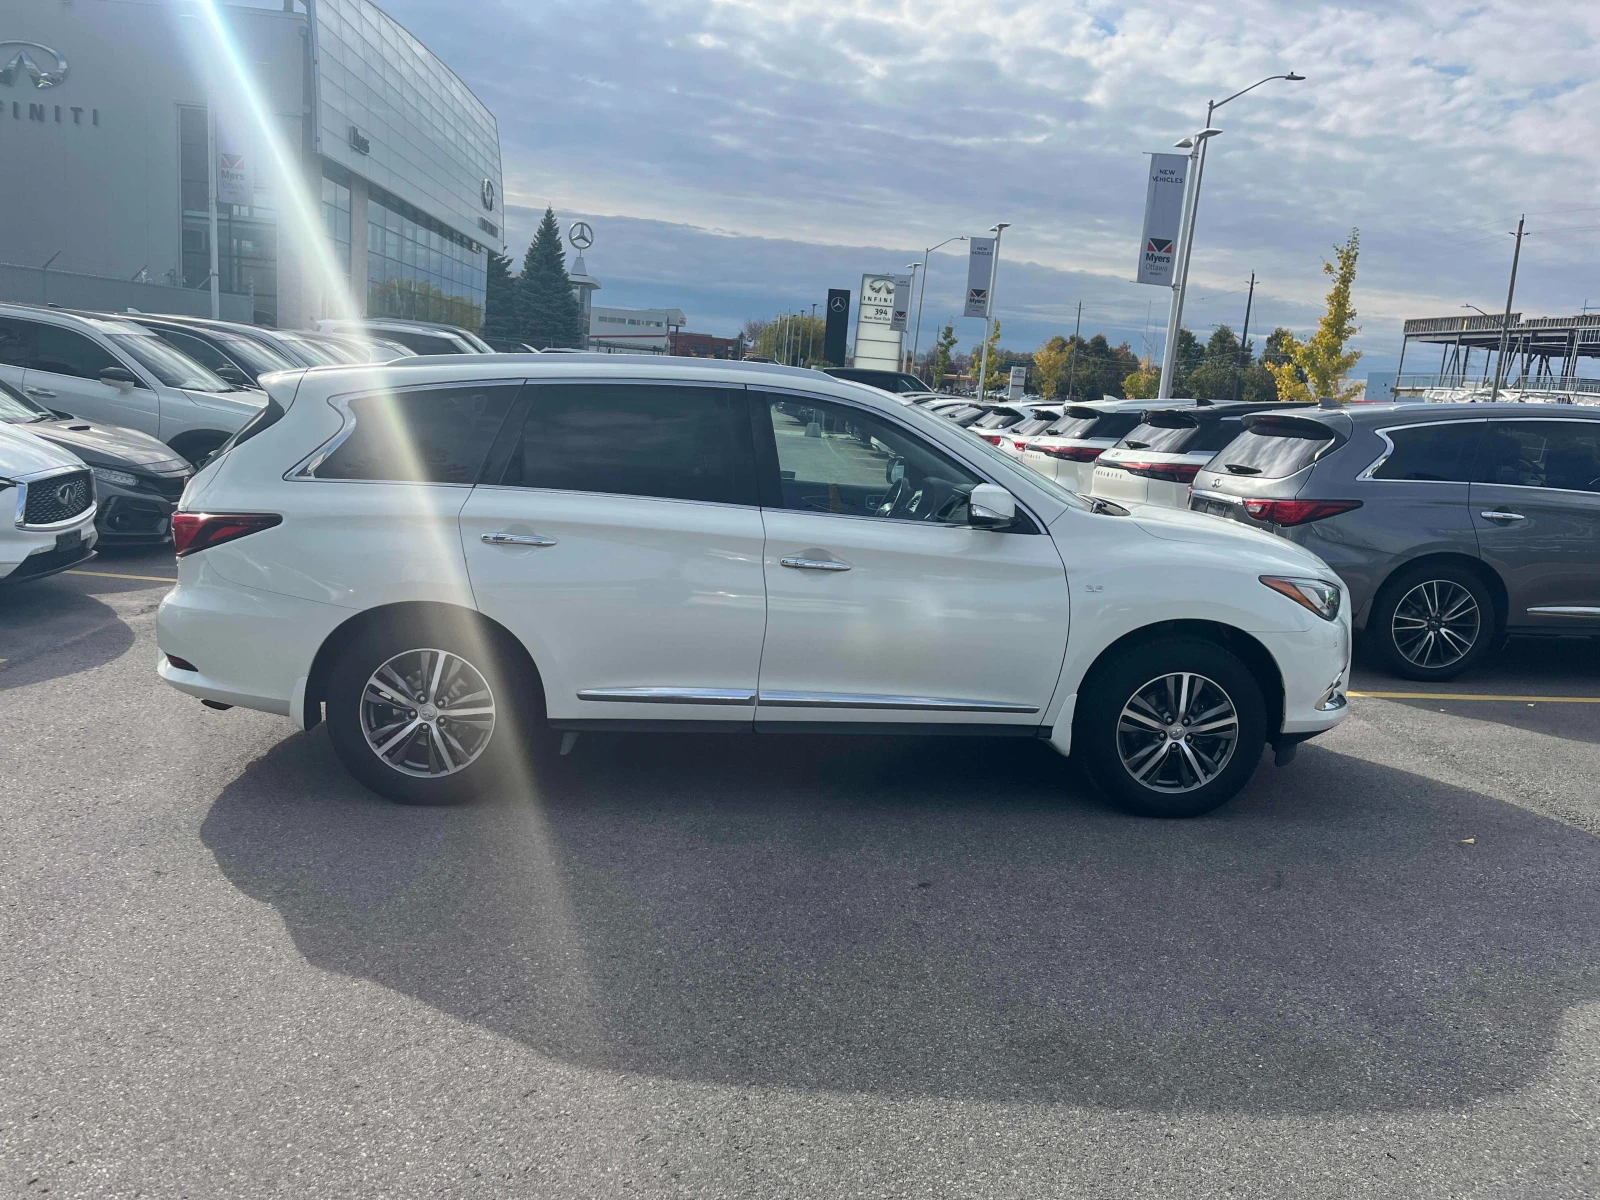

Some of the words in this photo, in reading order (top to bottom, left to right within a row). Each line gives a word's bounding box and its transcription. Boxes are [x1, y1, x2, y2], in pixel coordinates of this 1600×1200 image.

[221, 169, 245, 181] Myers
[1152, 176, 1183, 184] VEHICLES
[1145, 253, 1171, 264] Myers
[1145, 263, 1168, 272] Ottawa
[863, 296, 892, 304] INFINI
